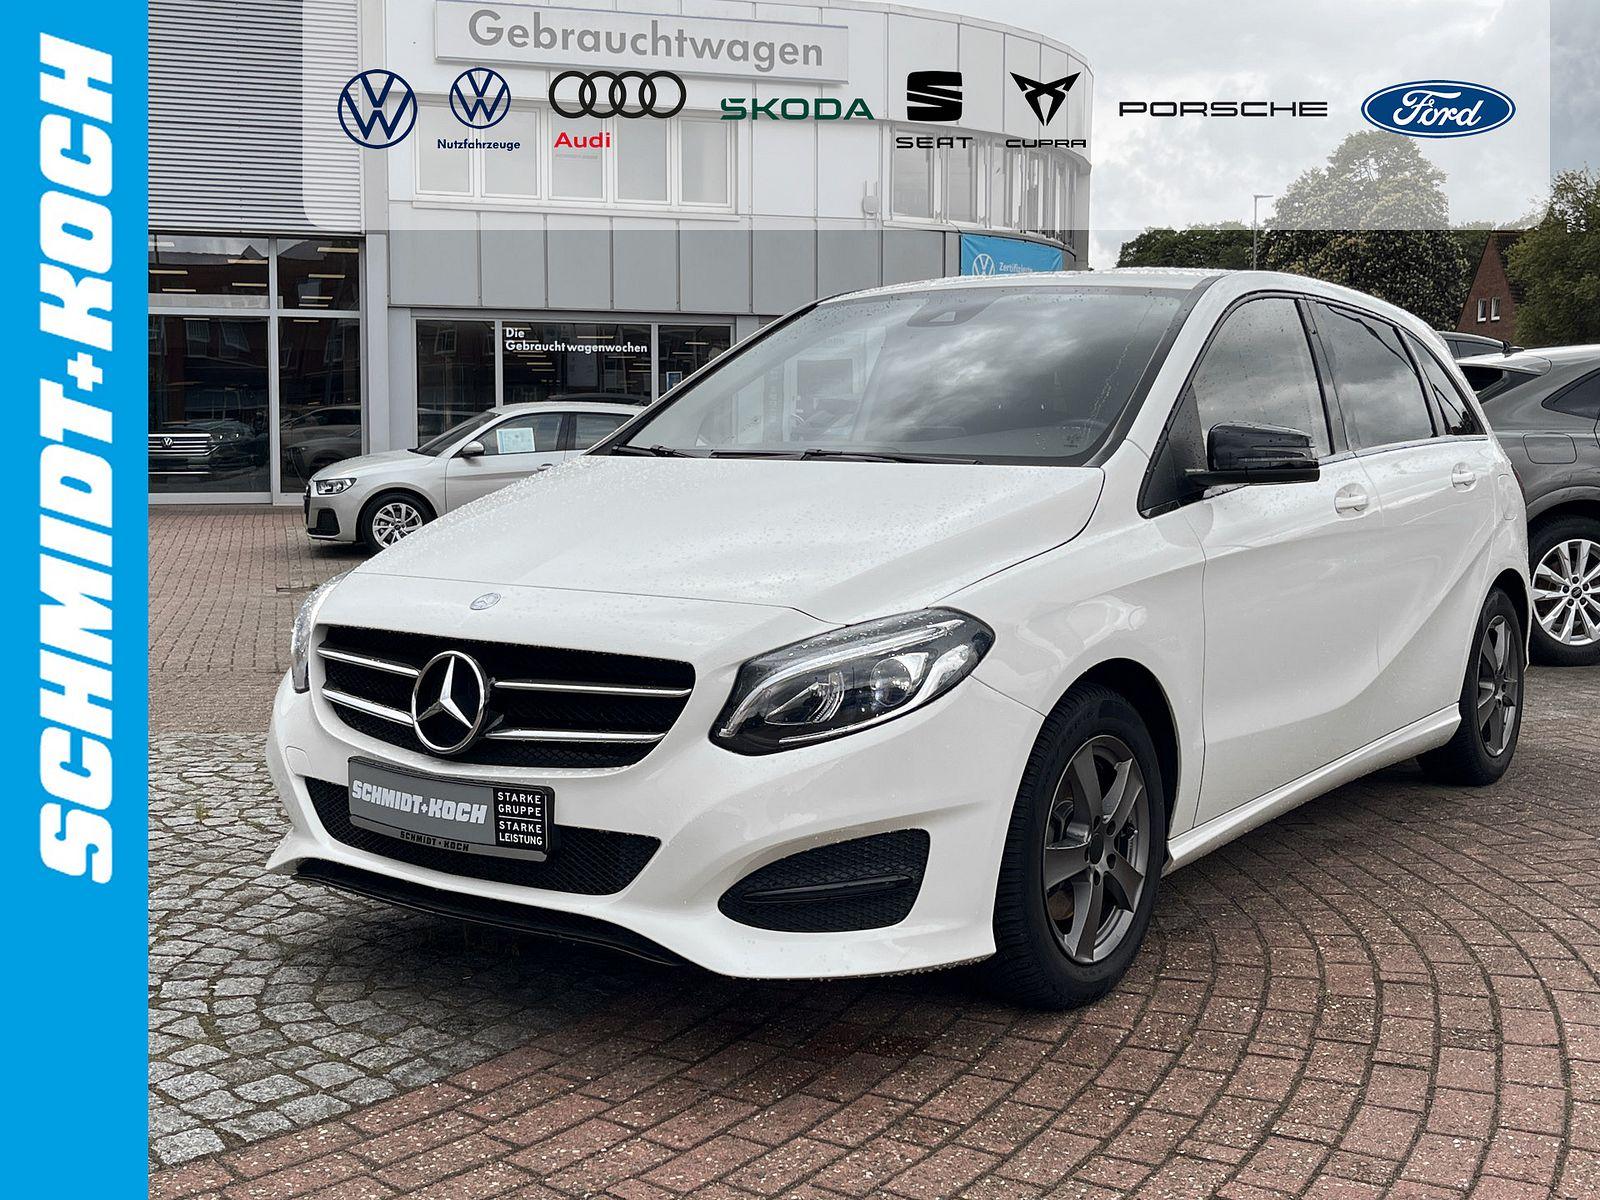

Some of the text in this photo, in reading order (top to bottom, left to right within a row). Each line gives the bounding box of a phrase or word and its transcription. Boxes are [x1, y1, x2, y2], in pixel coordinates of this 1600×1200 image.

[467, 10, 824, 72] Gebrauchtwagen
[505, 328, 525, 339] Die
[352, 780, 488, 824] SCHMIDT+KOCH
[497, 792, 542, 805] STARKE
[498, 804, 542, 817] GRUPPE
[499, 821, 542, 833] STARKE
[400, 831, 469, 851] SCHMIDT KOCH
[499, 832, 543, 846] LEISTUNG
